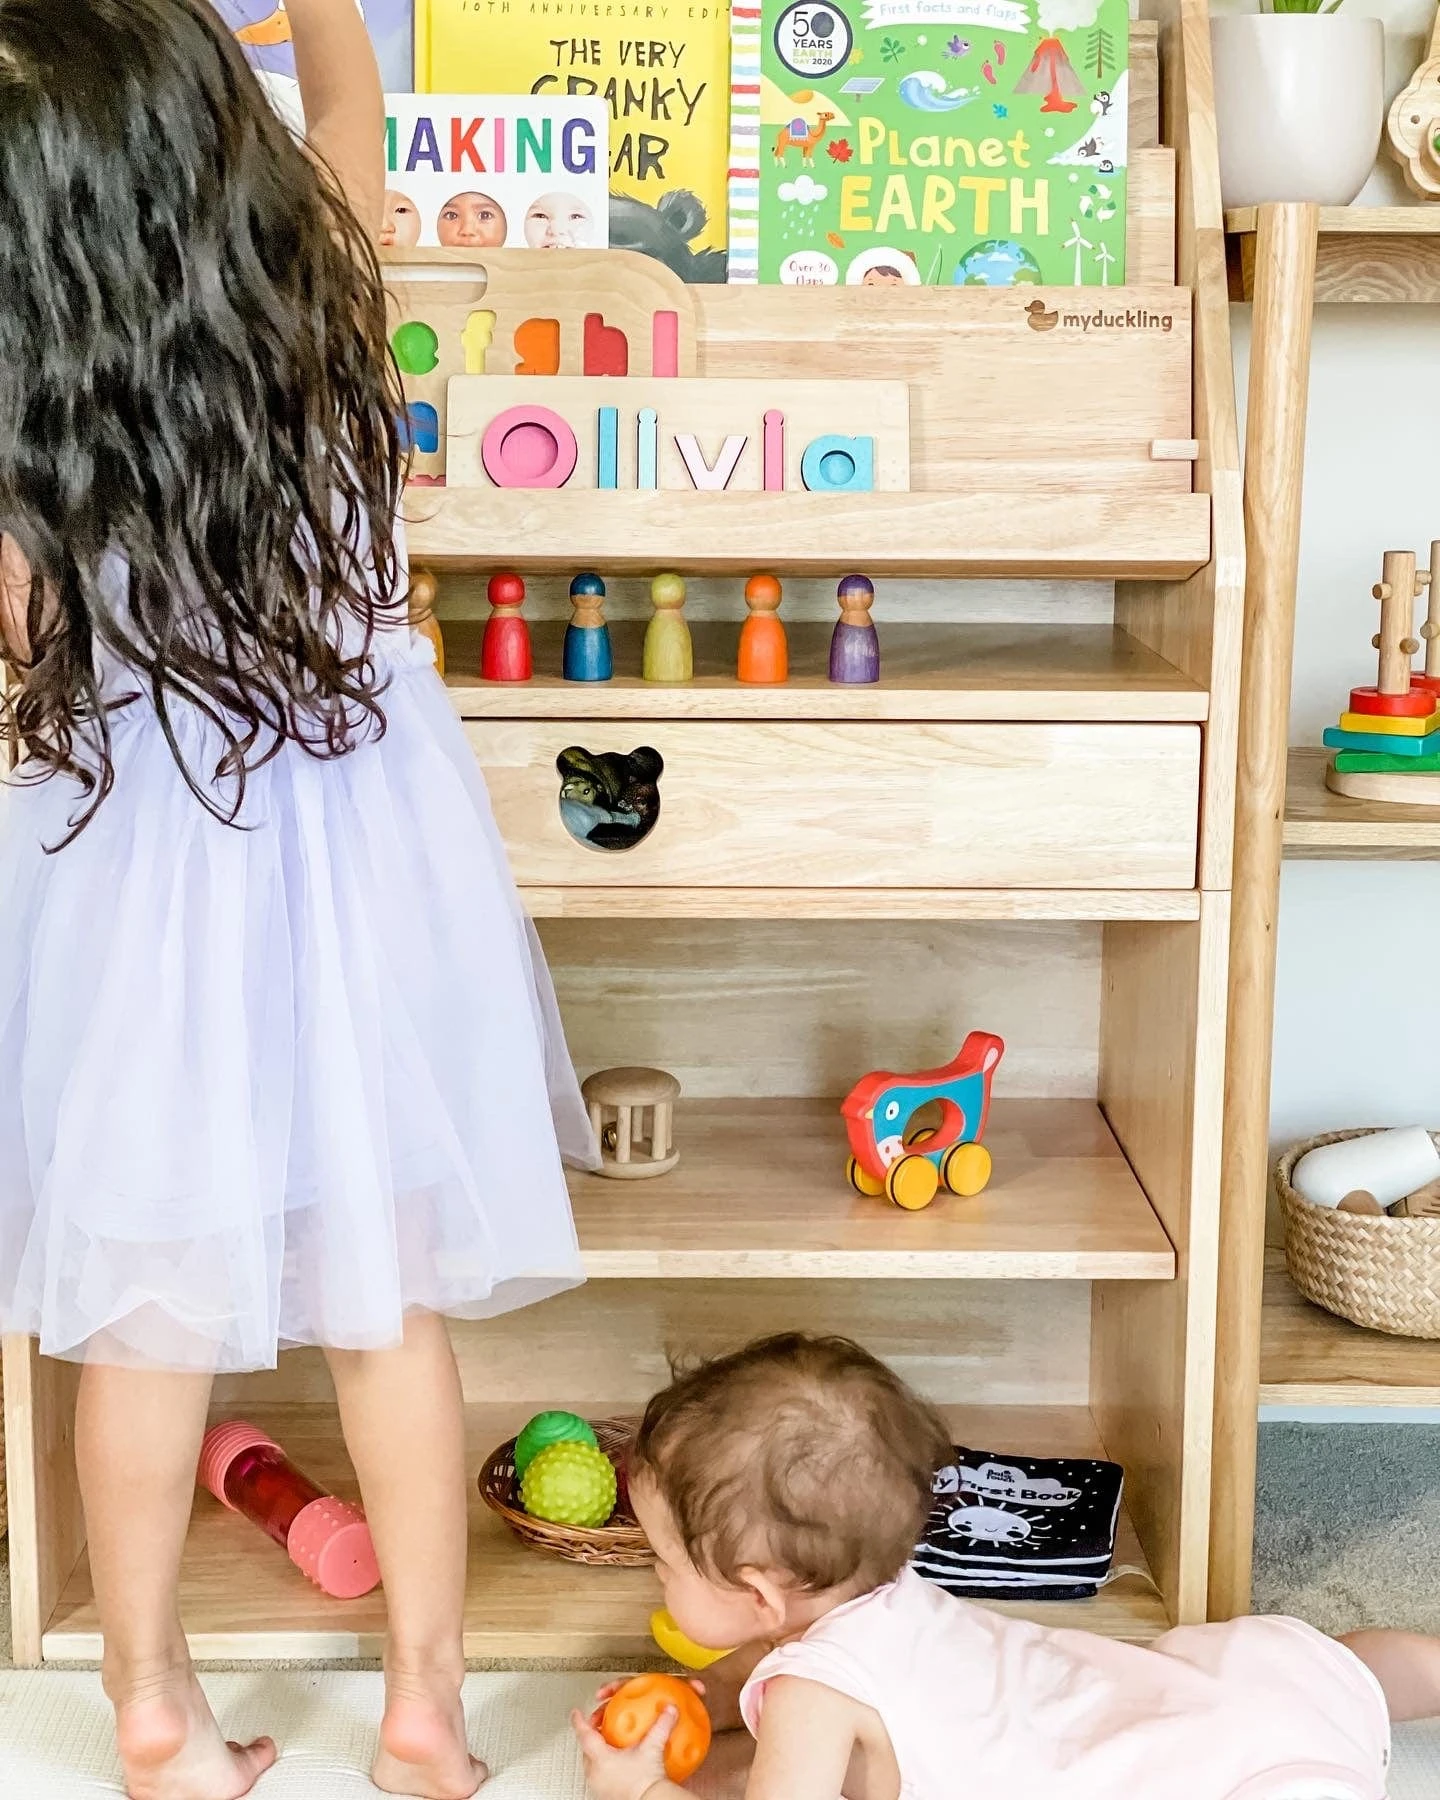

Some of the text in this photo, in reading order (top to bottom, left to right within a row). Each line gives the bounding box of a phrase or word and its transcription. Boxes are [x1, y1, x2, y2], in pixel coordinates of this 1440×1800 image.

[463, 1, 510, 13] 10TH
[530, 2, 668, 19] ANNIVERSARY
[879, 0, 1017, 21] First facts and flaps
[550, 38, 686, 68] THE VERY
[793, 38, 833, 49] YEARS
[793, 48, 833, 58] EARTH
[793, 57, 810, 65] DAY
[608, 132, 670, 181] AR
[839, 174, 1049, 236] EARTH
[1063, 309, 1173, 332] myduckling
[481, 404, 875, 492] Olivia
[1021, 1489, 1081, 1500] Book
